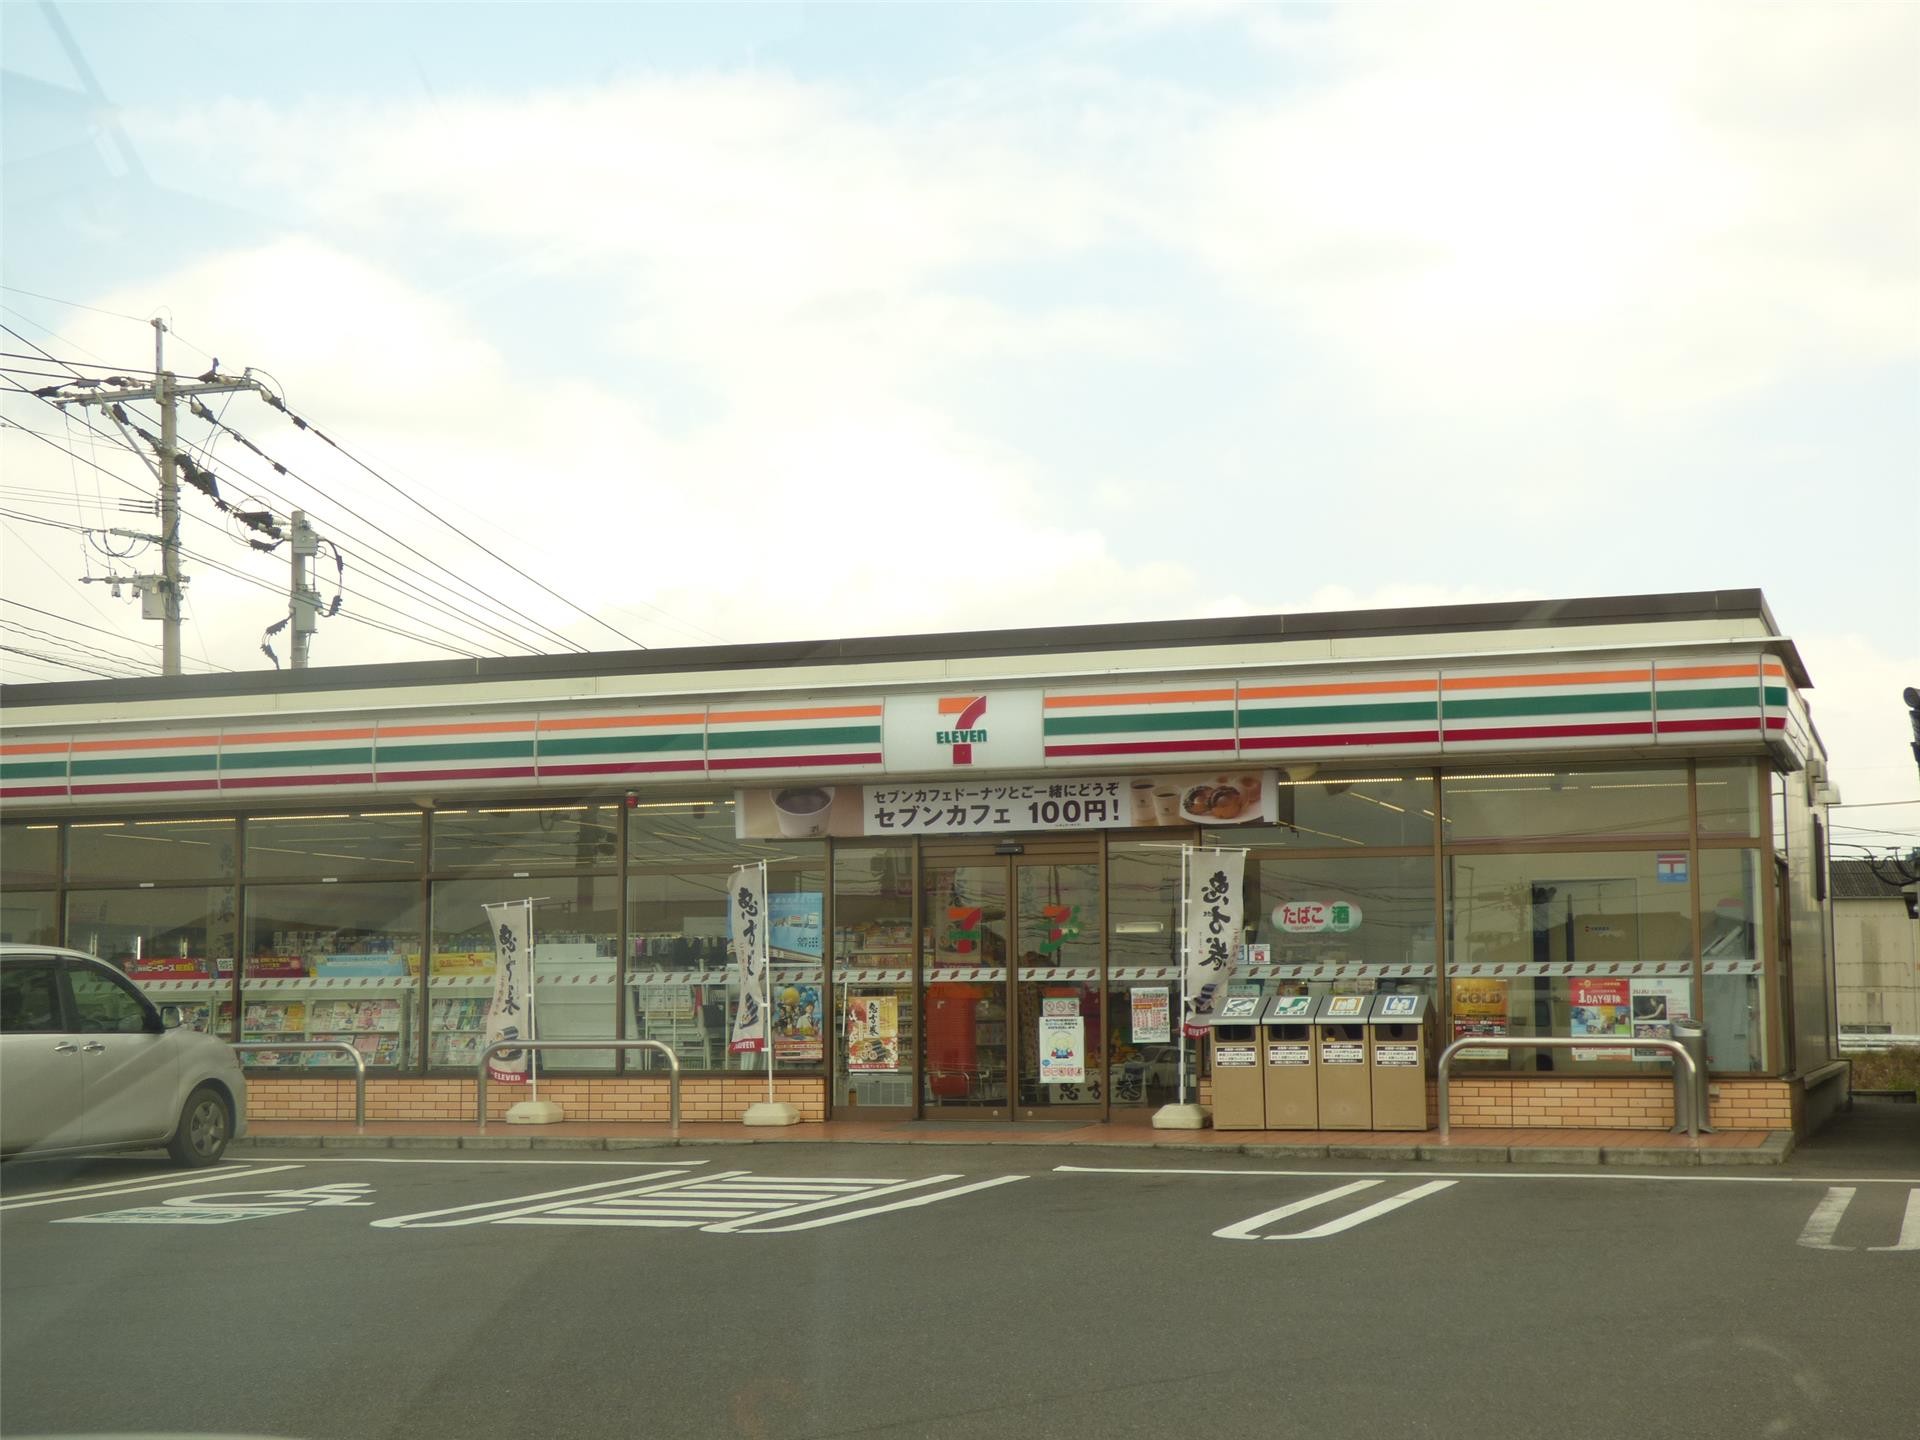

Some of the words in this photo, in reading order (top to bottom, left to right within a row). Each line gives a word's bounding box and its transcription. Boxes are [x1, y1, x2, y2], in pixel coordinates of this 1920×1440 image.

[874, 782, 1119, 805] セブンカフェドーナツとご一緒にどうぞ
[874, 804, 1011, 829] セブンカフェ
[1028, 799, 1120, 825] 100円!
[1283, 905, 1324, 925] たばこ
[1332, 905, 1350, 925] 酒
